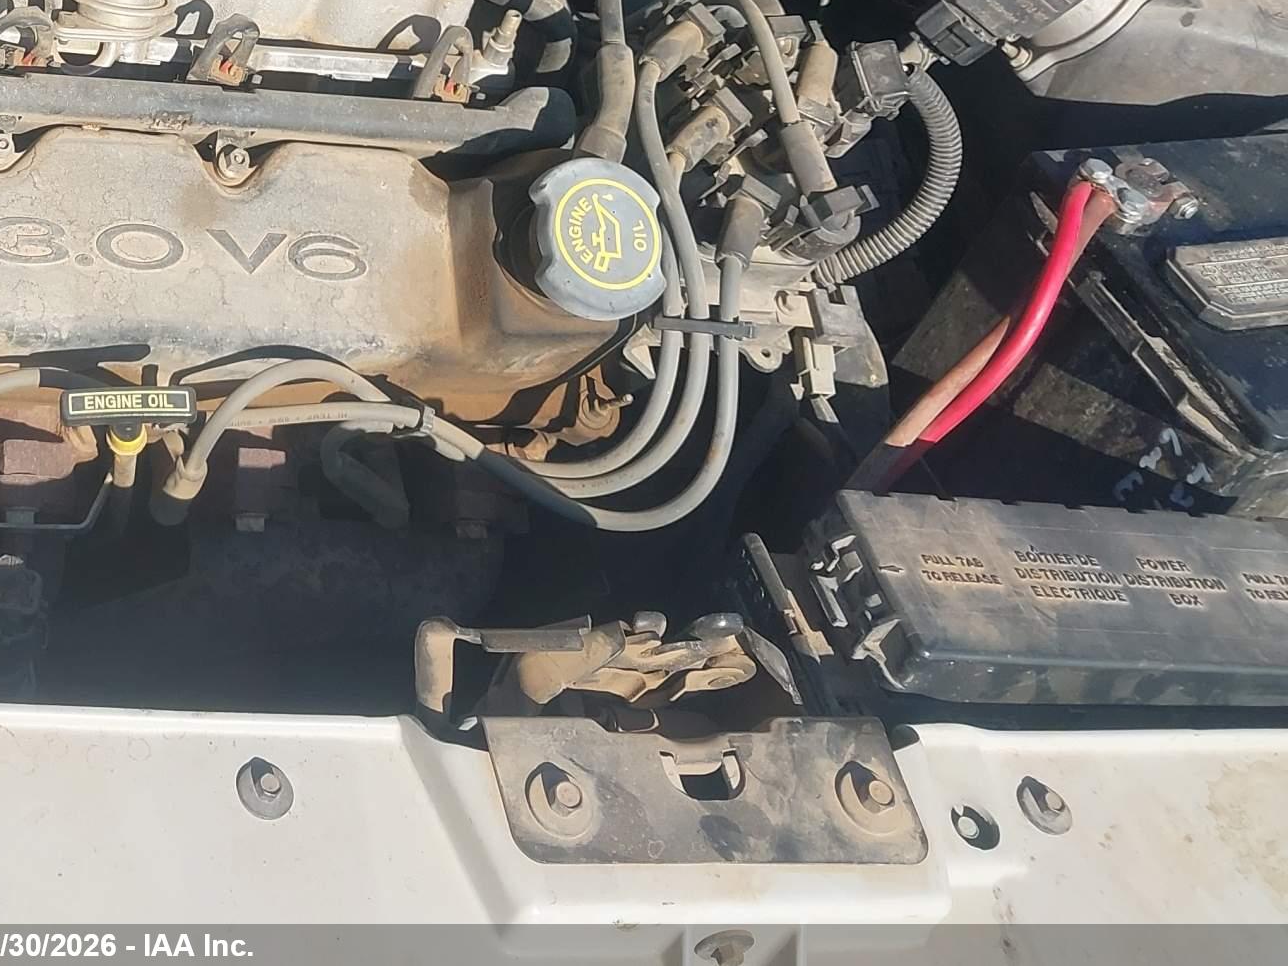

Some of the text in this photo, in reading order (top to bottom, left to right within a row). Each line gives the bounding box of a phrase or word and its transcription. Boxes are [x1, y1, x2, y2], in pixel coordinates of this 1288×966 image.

[567, 196, 595, 265] ENGINE
[632, 219, 648, 252] OIL
[205, 228, 368, 282] V6
[83, 393, 175, 410] ENGINE OIL
[920, 553, 984, 568] PULL TAB
[1075, 552, 1102, 567] DE
[1135, 556, 1191, 572] POWER
[921, 569, 1003, 585] TO RELEASE
[1013, 566, 1122, 585] DISTRIBUTION
[1122, 573, 1227, 591] DISTRIBUTION
[1241, 572, 1277, 585] PULL
[1030, 585, 1128, 603] ELECTRIQUE
[1168, 592, 1204, 607] BOX
[1245, 588, 1266, 600] TO
